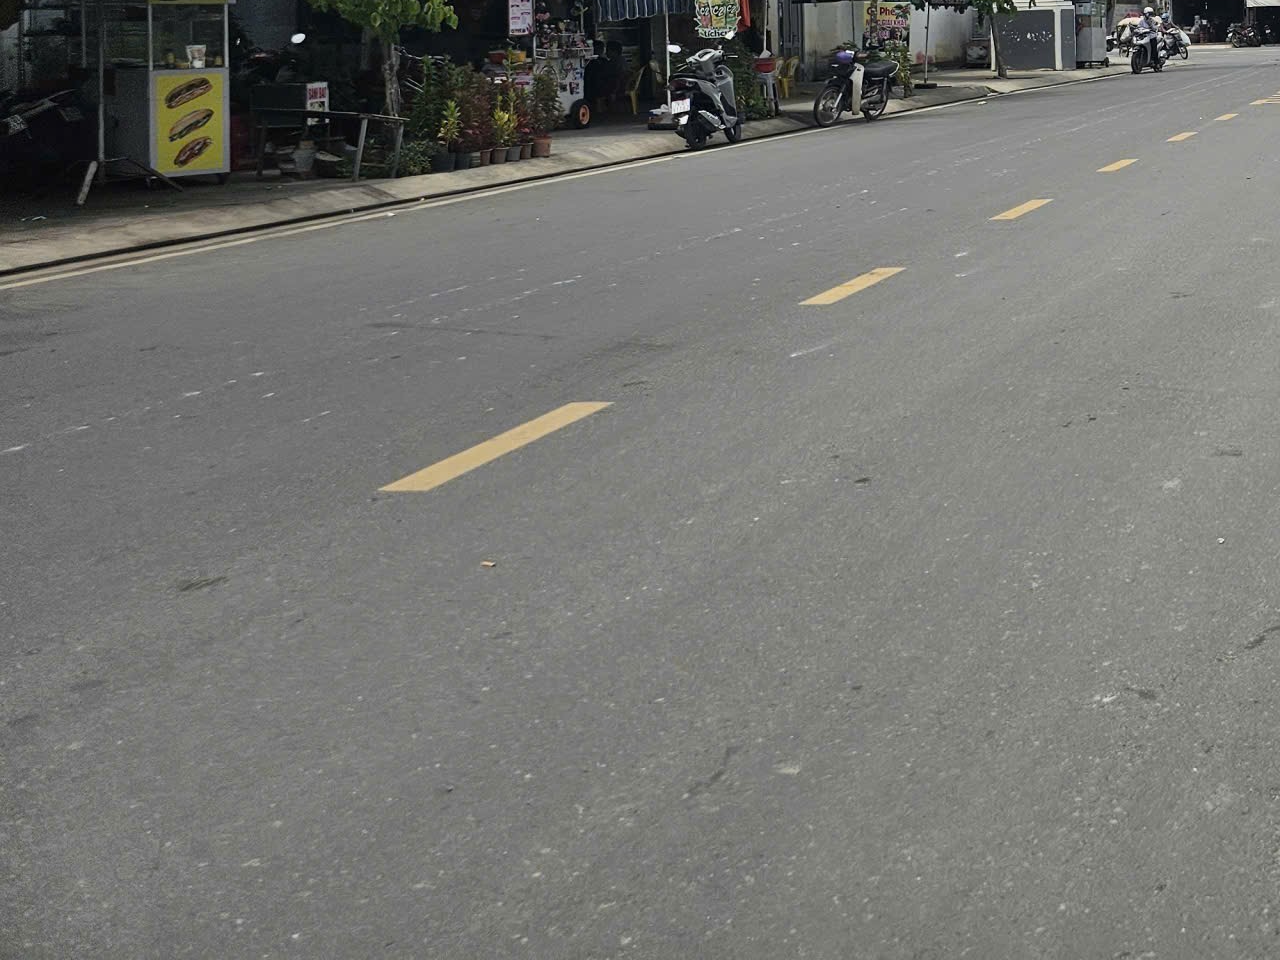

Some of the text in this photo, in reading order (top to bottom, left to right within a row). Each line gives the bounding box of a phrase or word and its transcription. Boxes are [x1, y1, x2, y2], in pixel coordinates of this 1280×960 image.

[700, 6, 710, 16] C2
[712, 5, 724, 17] C2
[726, 4, 737, 14] C2
